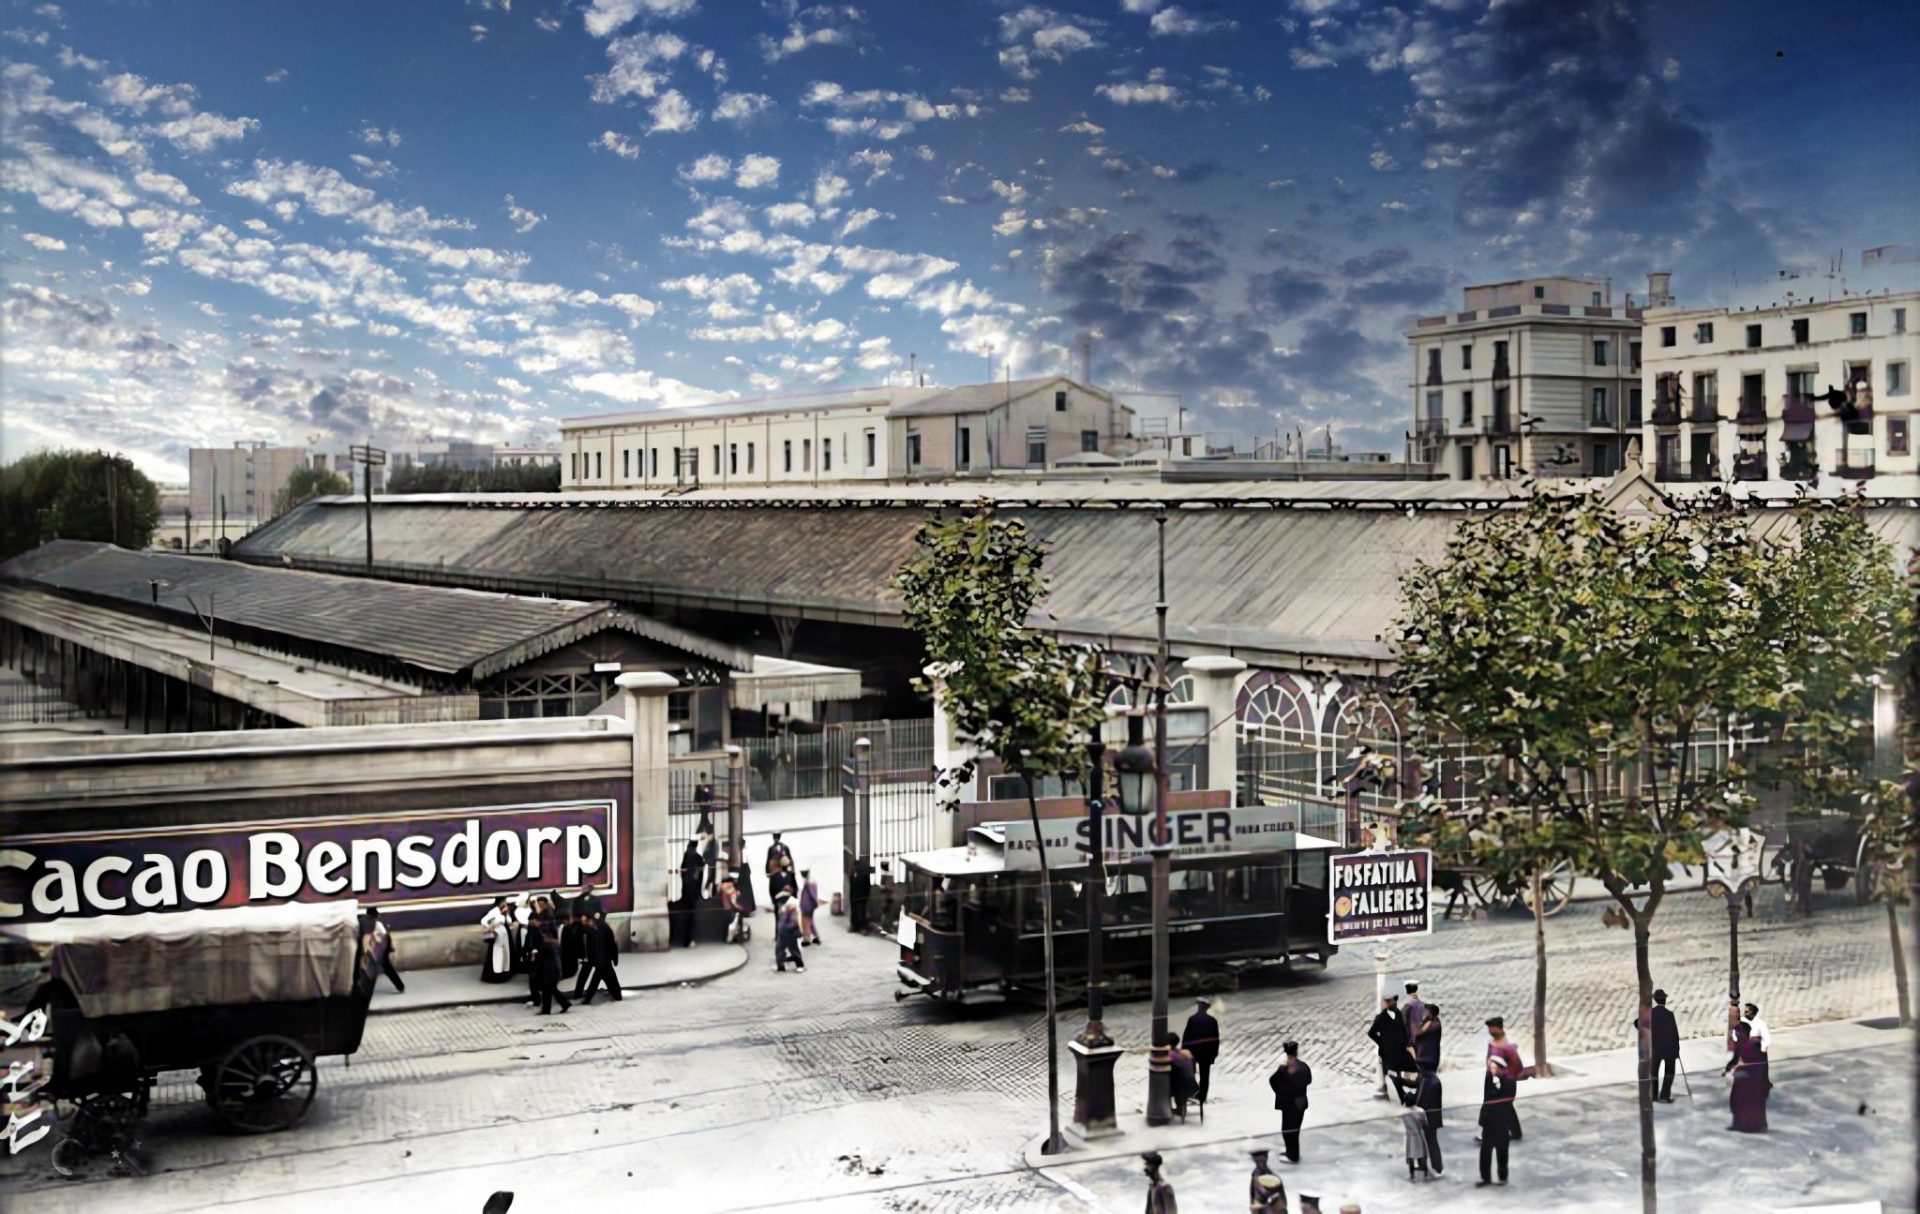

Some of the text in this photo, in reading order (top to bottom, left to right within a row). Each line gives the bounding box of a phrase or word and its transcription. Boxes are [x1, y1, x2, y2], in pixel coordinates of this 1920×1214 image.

[1075, 812, 1231, 850] SINGER
[0, 819, 603, 918] Cacao Bensdorp
[1334, 859, 1417, 889] FOSFATINA
